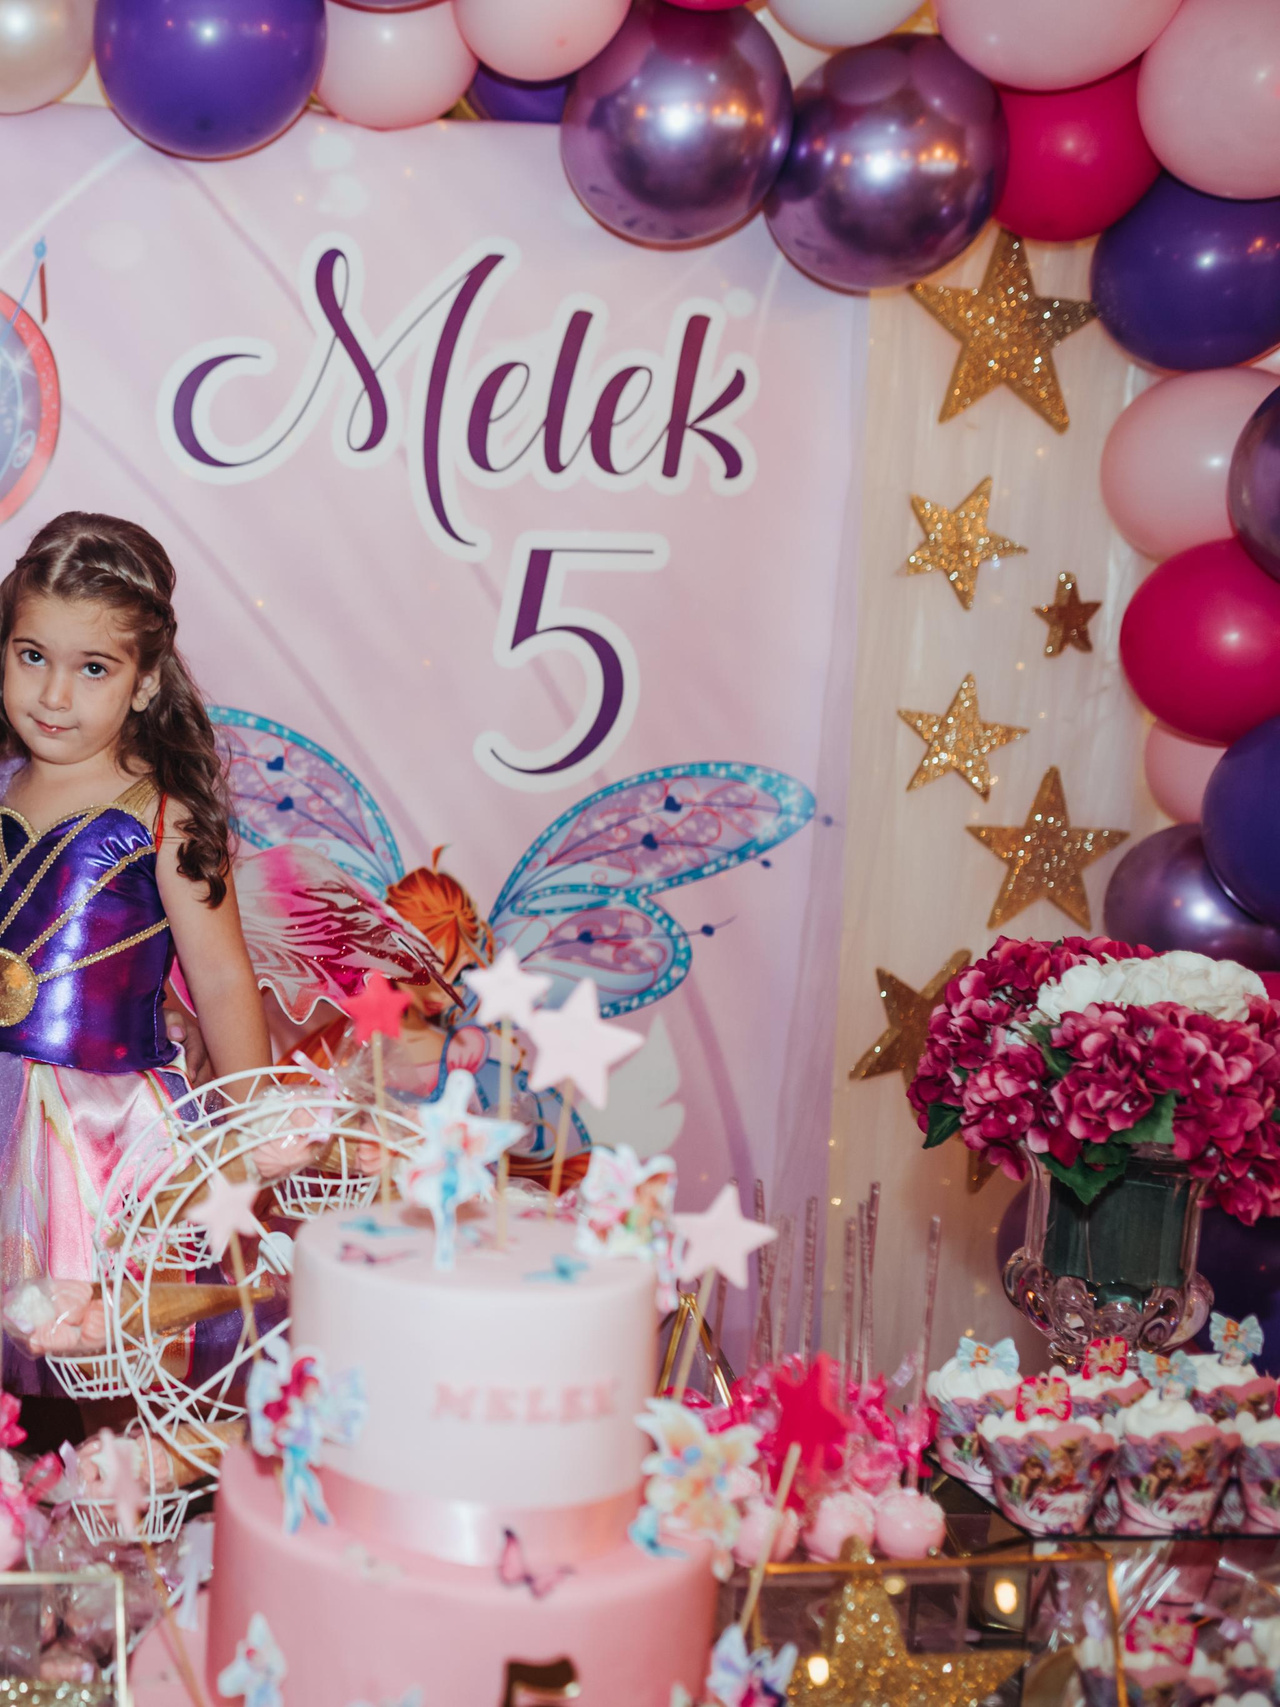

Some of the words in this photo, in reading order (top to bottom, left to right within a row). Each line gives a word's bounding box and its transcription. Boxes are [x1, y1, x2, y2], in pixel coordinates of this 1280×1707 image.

[173, 249, 745, 546] Melek
[491, 549, 654, 774] 5
[430, 1377, 620, 1424] MELEK
